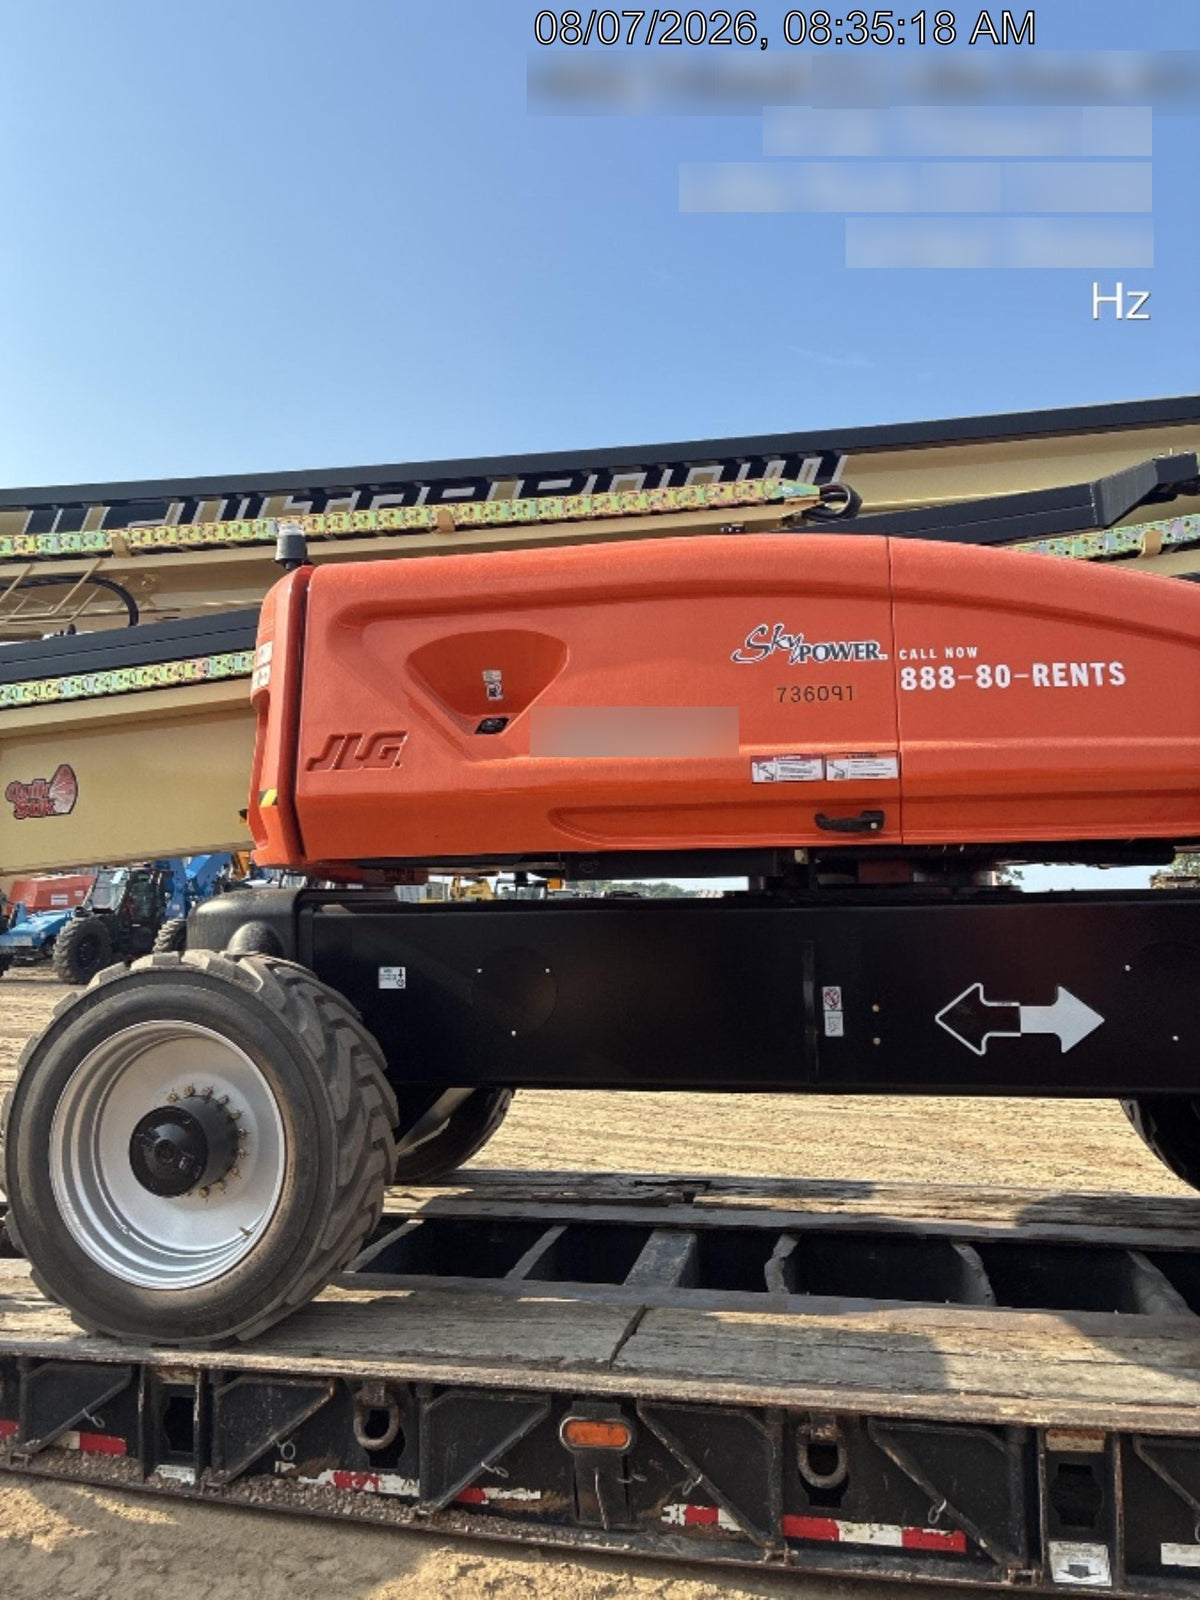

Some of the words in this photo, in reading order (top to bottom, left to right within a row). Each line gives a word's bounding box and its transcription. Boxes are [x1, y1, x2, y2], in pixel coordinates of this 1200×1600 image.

[899, 648, 938, 661] CALL
[945, 646, 978, 659] NOW
[900, 661, 1127, 691] 888-80-RENTS
[776, 685, 854, 703] 736091
[305, 729, 408, 774] JLG
